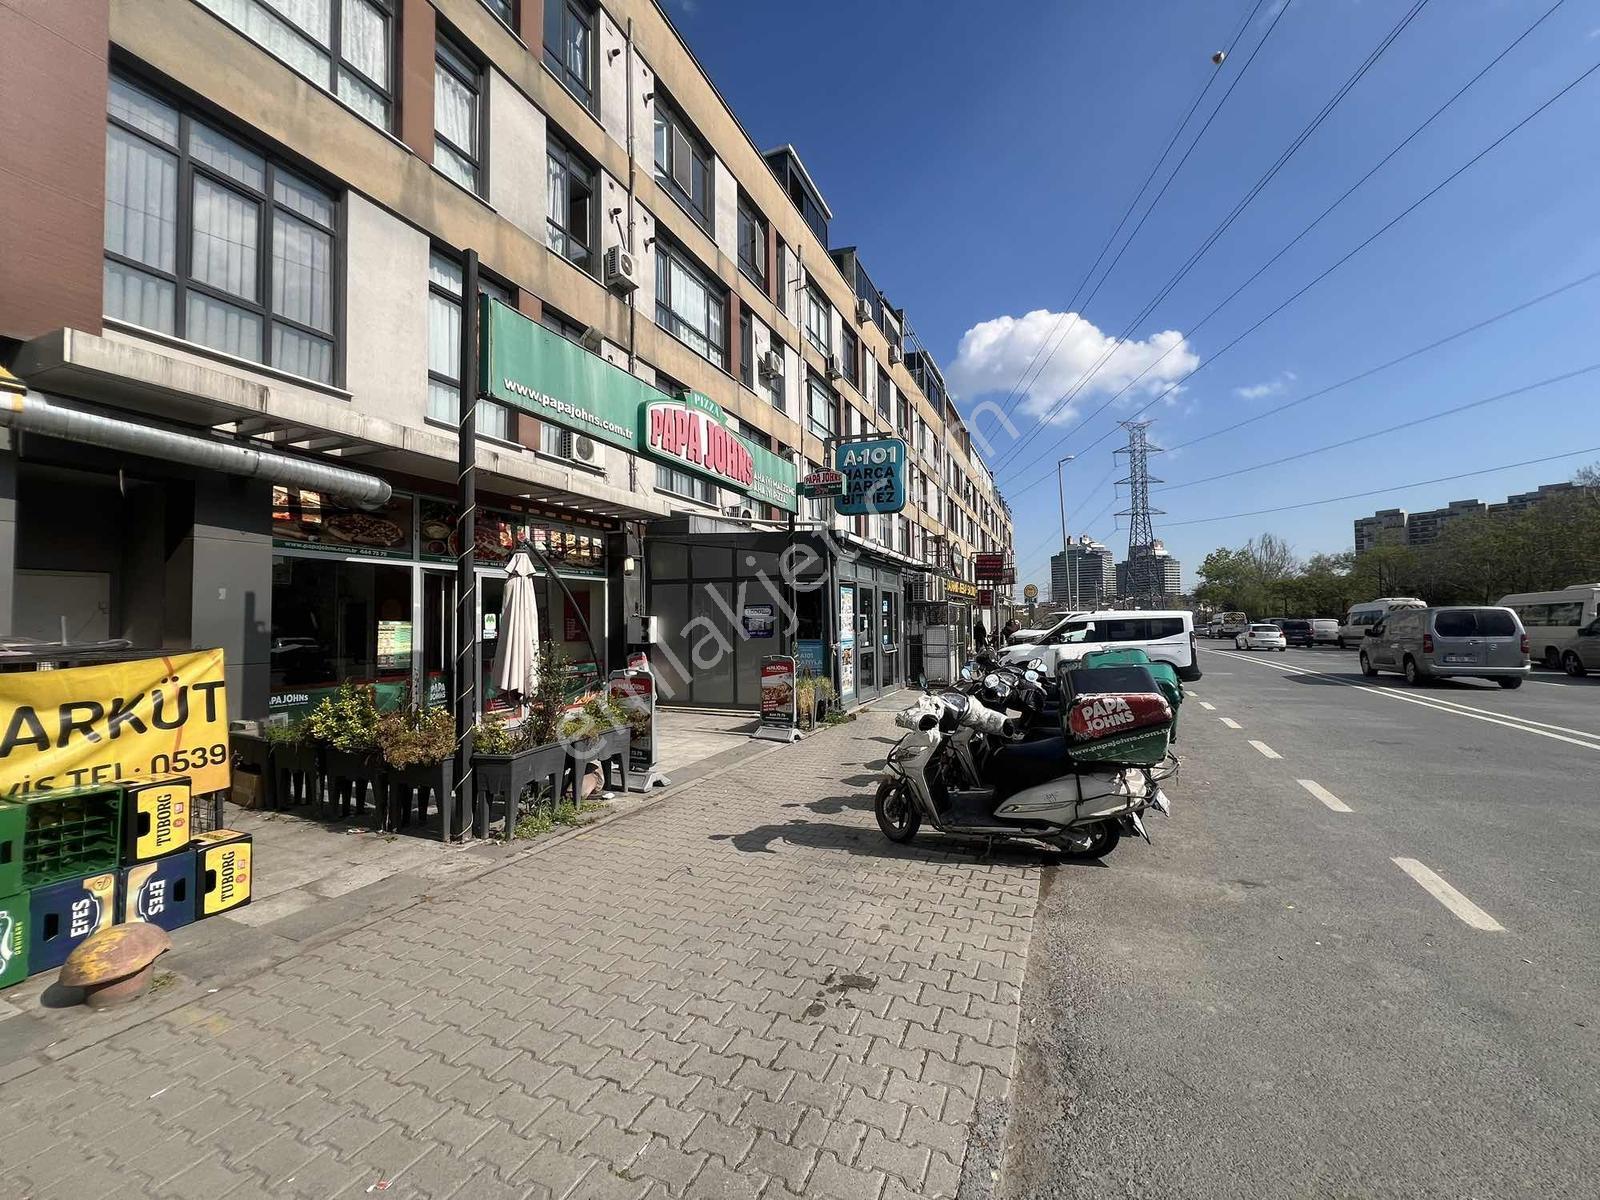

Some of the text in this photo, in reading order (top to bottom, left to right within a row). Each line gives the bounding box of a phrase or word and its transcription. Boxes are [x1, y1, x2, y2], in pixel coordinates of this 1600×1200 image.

[503, 378, 633, 440] www.papajohns.com.tr
[694, 393, 720, 418] PIZZA
[651, 407, 753, 486] PAPA JOHNS
[805, 474, 821, 485] PAPA
[282, 694, 309, 704] JOHNS
[1082, 697, 1130, 720] PAPA
[1086, 710, 1135, 732] JOHNS
[157, 793, 172, 847] TUBORG
[220, 850, 235, 903] TUBORG
[147, 879, 166, 917] EFES
[70, 898, 91, 938] EFES
